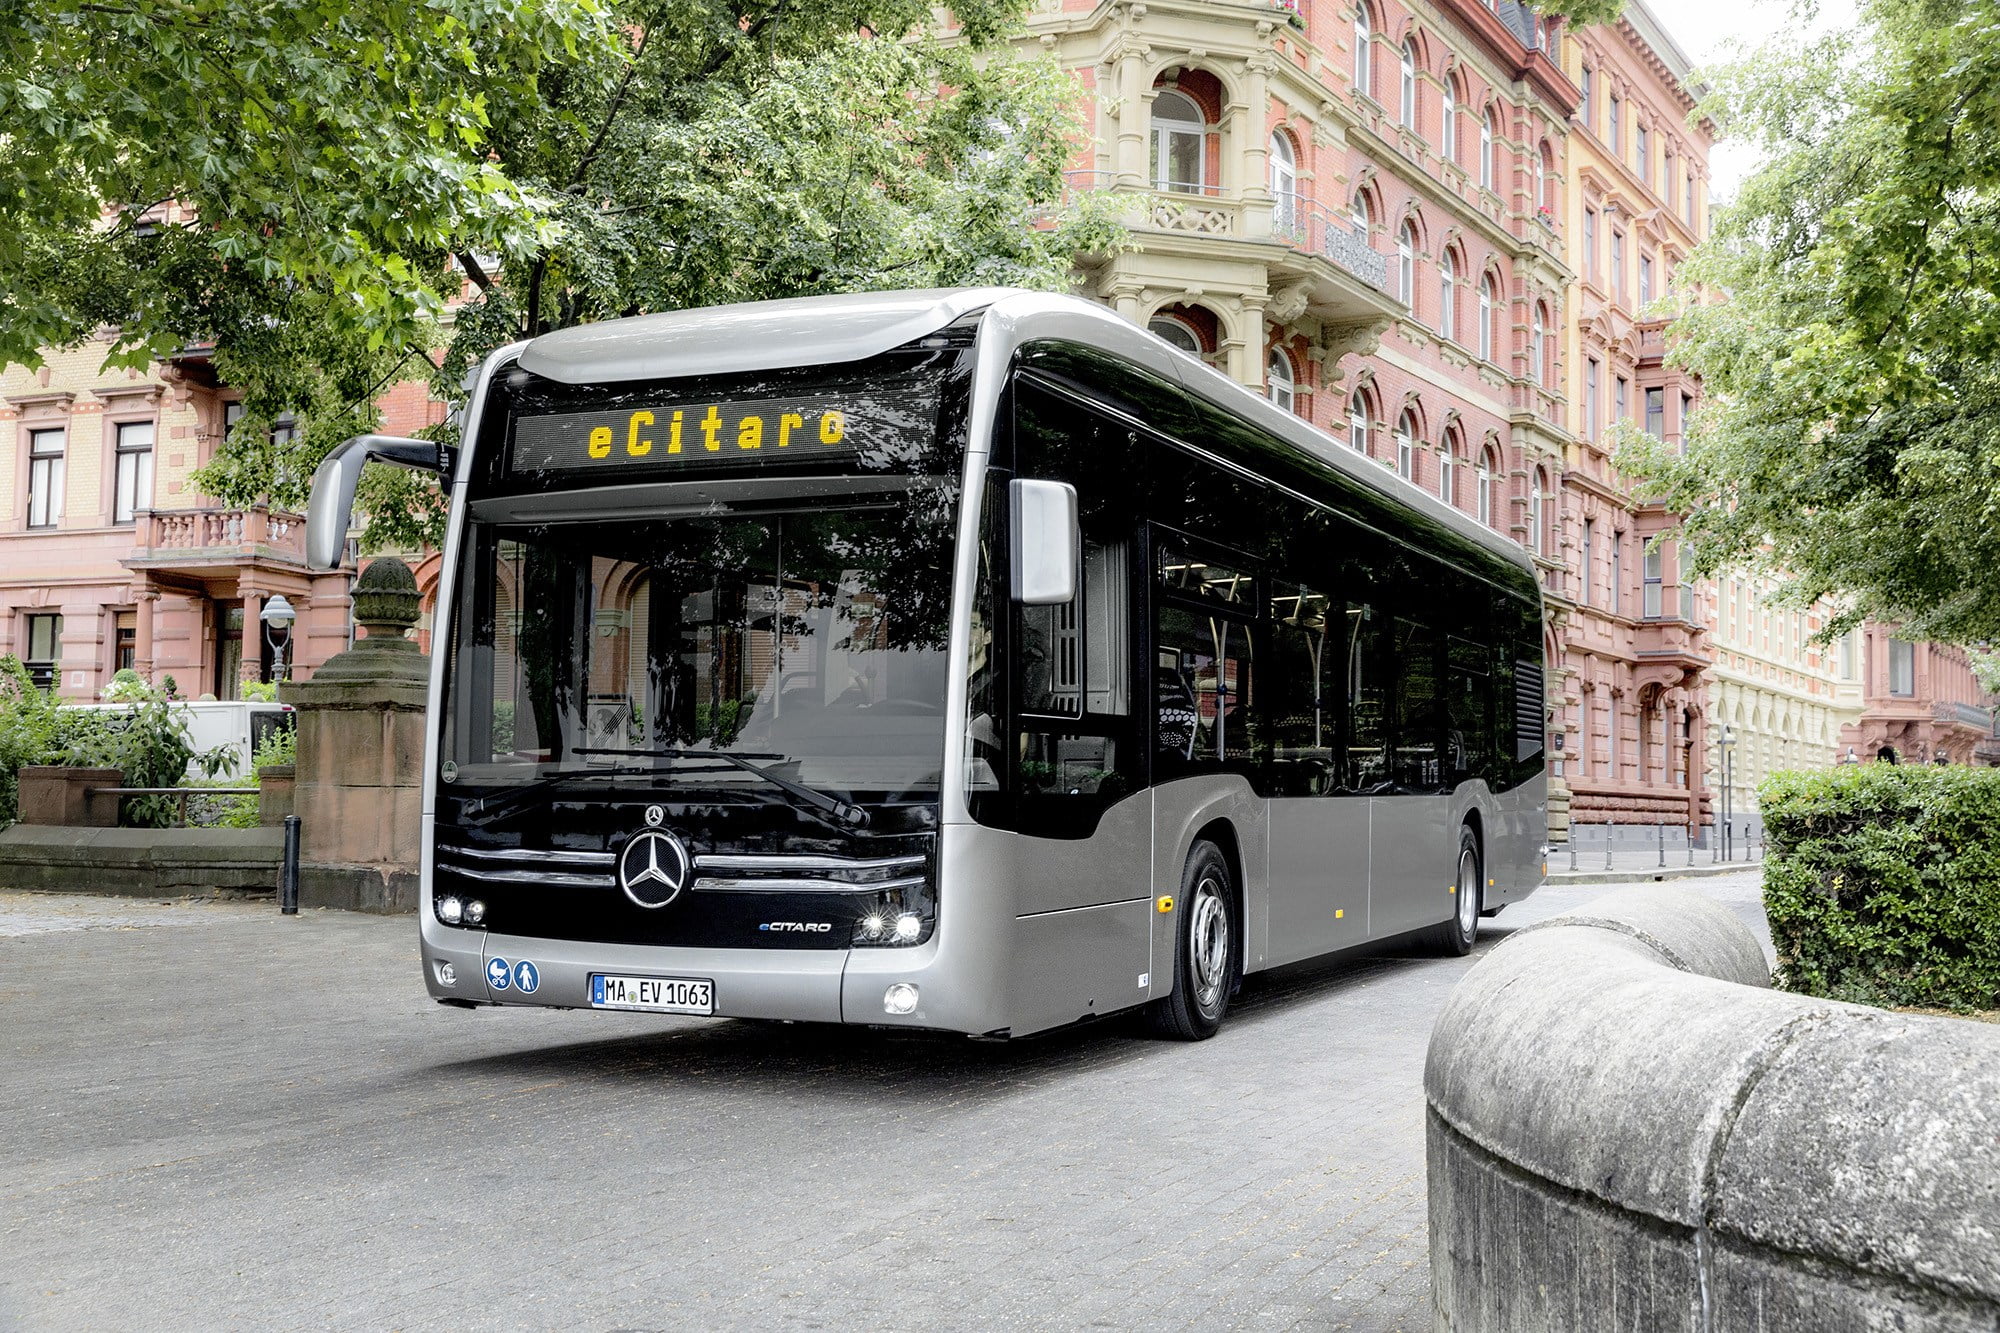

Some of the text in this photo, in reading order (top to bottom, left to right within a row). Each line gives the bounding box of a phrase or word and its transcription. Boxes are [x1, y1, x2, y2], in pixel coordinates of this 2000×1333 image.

[588, 406, 844, 459] eCitaro
[759, 921, 832, 933] eCITARO
[605, 979, 709, 1006] MA EV 1063
